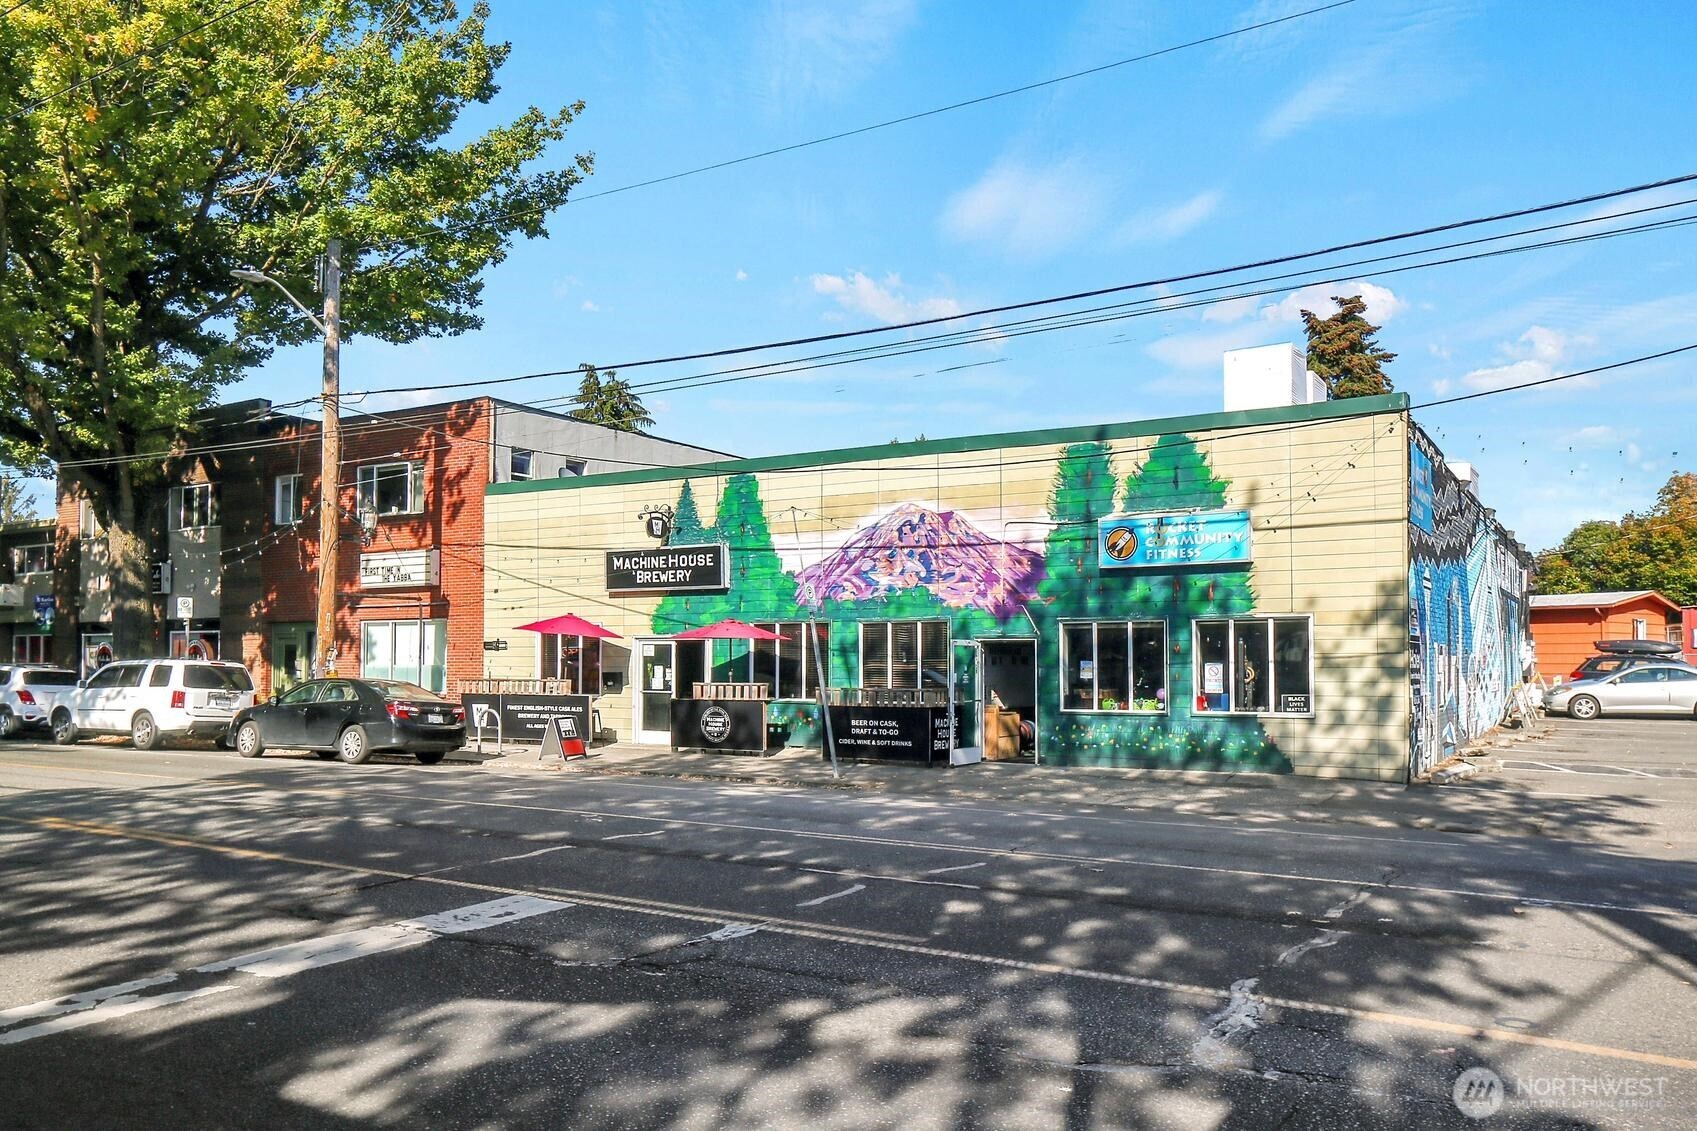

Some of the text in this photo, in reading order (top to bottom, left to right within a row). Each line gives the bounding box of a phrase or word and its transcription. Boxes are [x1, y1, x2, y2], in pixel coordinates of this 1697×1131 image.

[1145, 520, 1206, 534] ROCKET
[1144, 532, 1244, 547] COMMUNITY
[1146, 548, 1201, 560] FITNESS
[365, 567, 380, 576] FIRST
[382, 566, 394, 576] TIME
[636, 570, 692, 584] BREWERY
[393, 574, 412, 582] YABBA
[937, 728, 956, 738] HOUE
[934, 738, 959, 750] BREWRY
